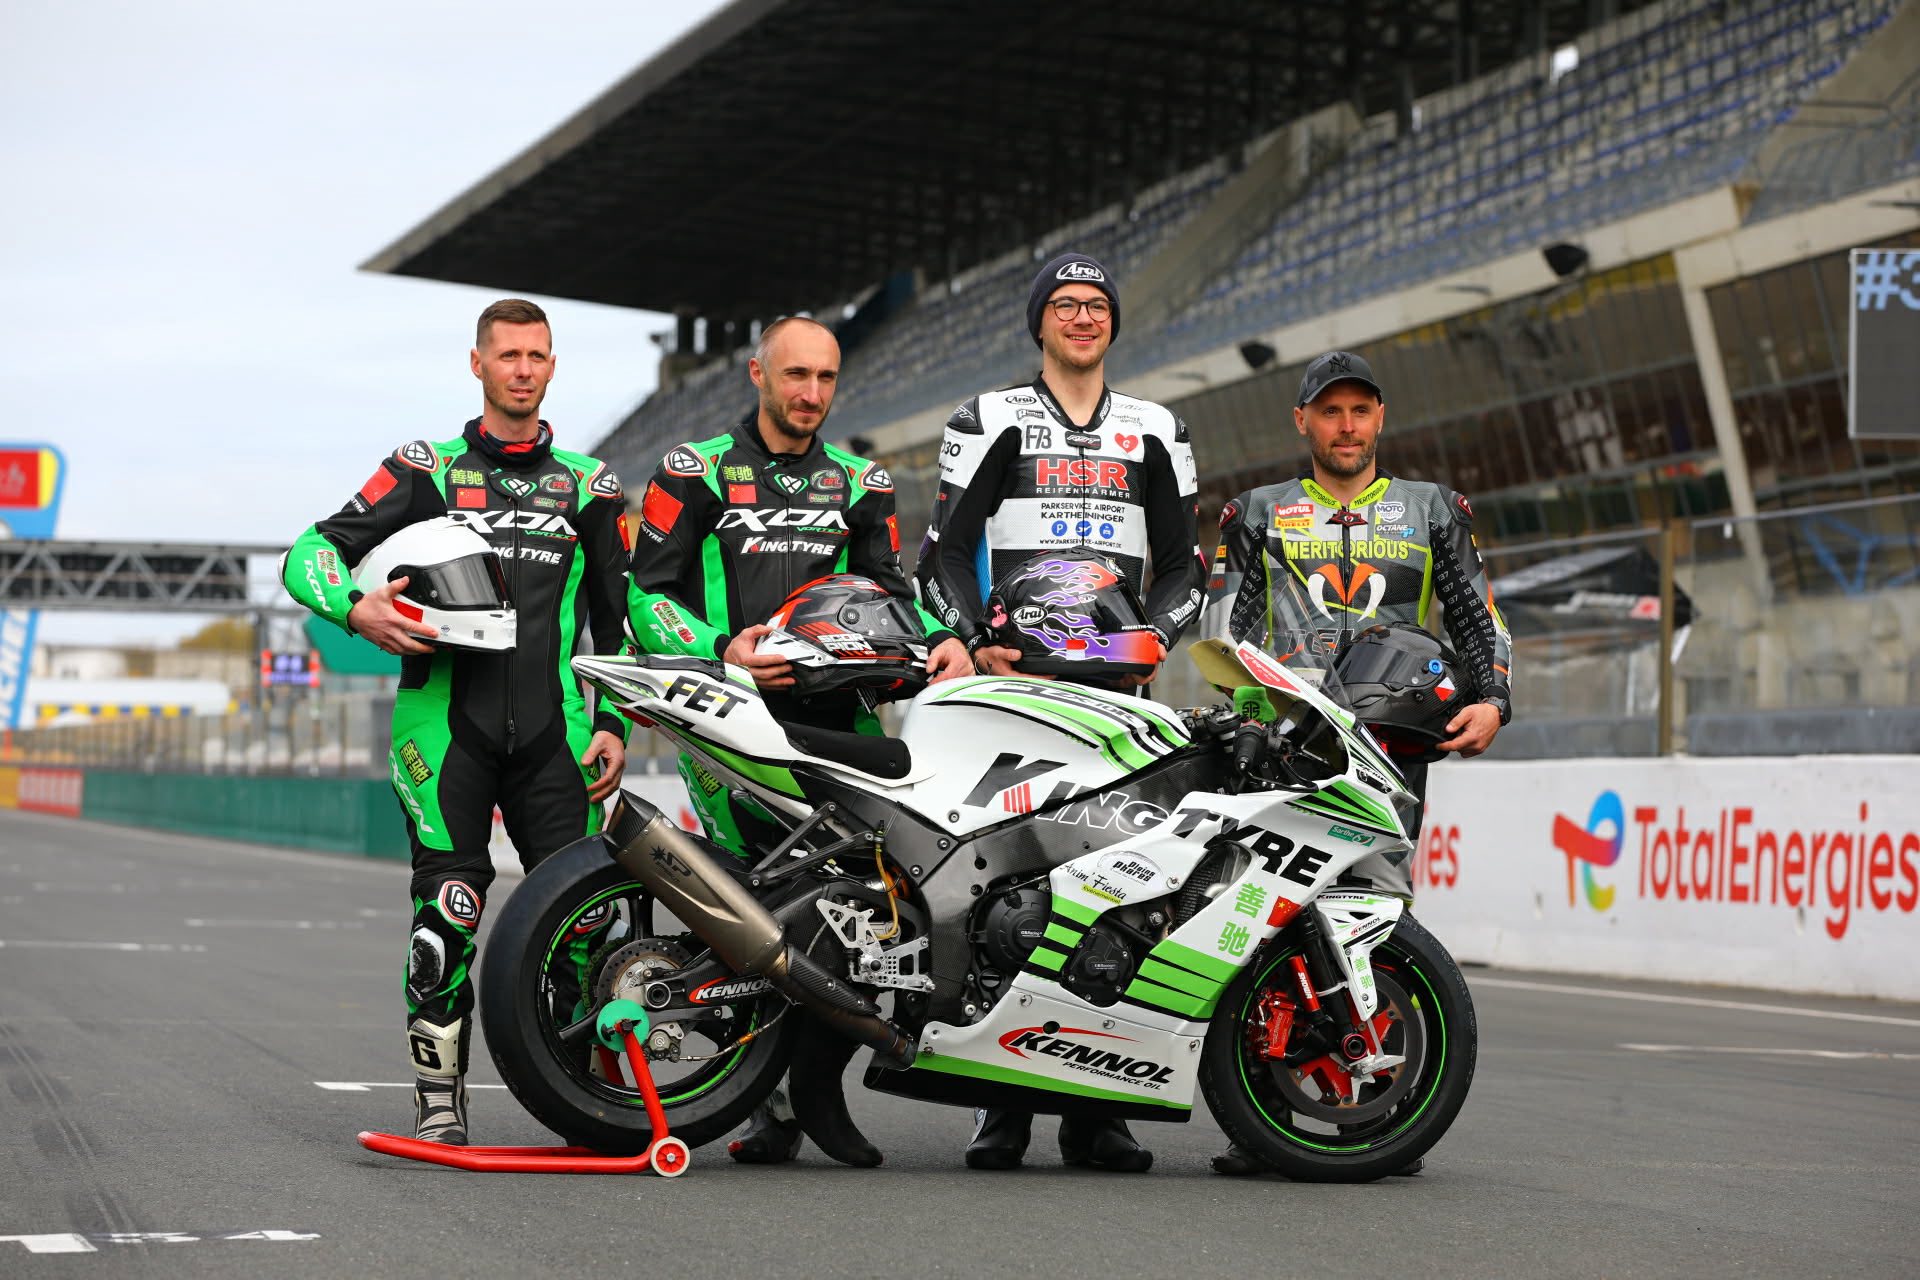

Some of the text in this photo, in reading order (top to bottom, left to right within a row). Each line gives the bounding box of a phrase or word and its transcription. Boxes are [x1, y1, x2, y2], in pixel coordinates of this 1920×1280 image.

[1062, 263, 1101, 278] Arai
[1036, 459, 1130, 491] HSR
[1094, 504, 1126, 514] AIRPORT
[1278, 504, 1312, 515] MOTUL
[1376, 504, 1404, 513] MOTO
[1285, 541, 1409, 560] MERITORIOUS
[927, 577, 949, 614] Allianz
[1017, 608, 1042, 620] Arai
[1168, 600, 1197, 624] Allianz
[663, 676, 749, 719] FET
[1332, 826, 1355, 837] Sarthe
[1634, 801, 1920, 941] TotalEnergies
[1093, 874, 1127, 900] Fiesta
[1352, 917, 1381, 934] KENNOL
[1298, 972, 1313, 999] SHOWA
[1009, 1031, 1176, 1084] KENNOL
[1062, 1061, 1162, 1091] PERFORMANCE OIL
